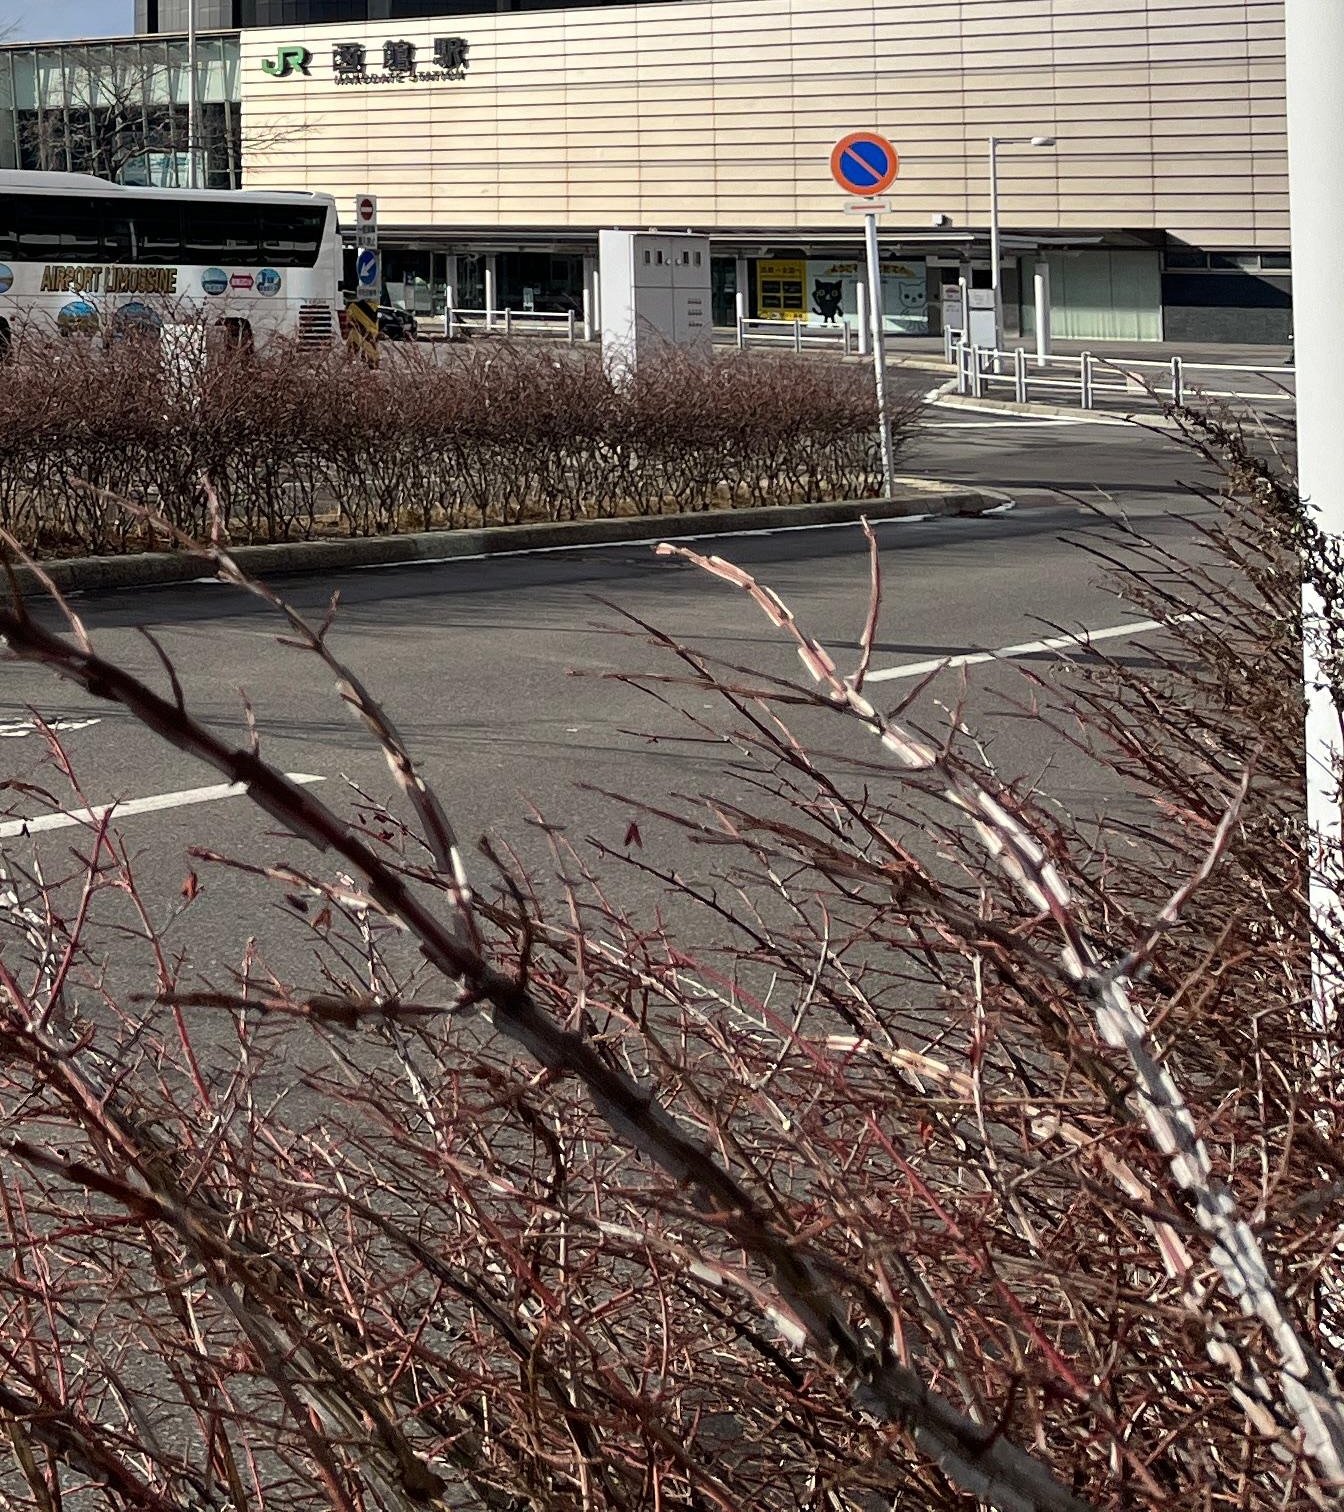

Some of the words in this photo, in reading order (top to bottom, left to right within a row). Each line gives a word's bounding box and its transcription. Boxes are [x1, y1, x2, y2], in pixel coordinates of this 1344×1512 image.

[262, 45, 312, 77] JR
[40, 265, 102, 293] AIRPORT
[104, 263, 177, 294] LIMOUSINE
